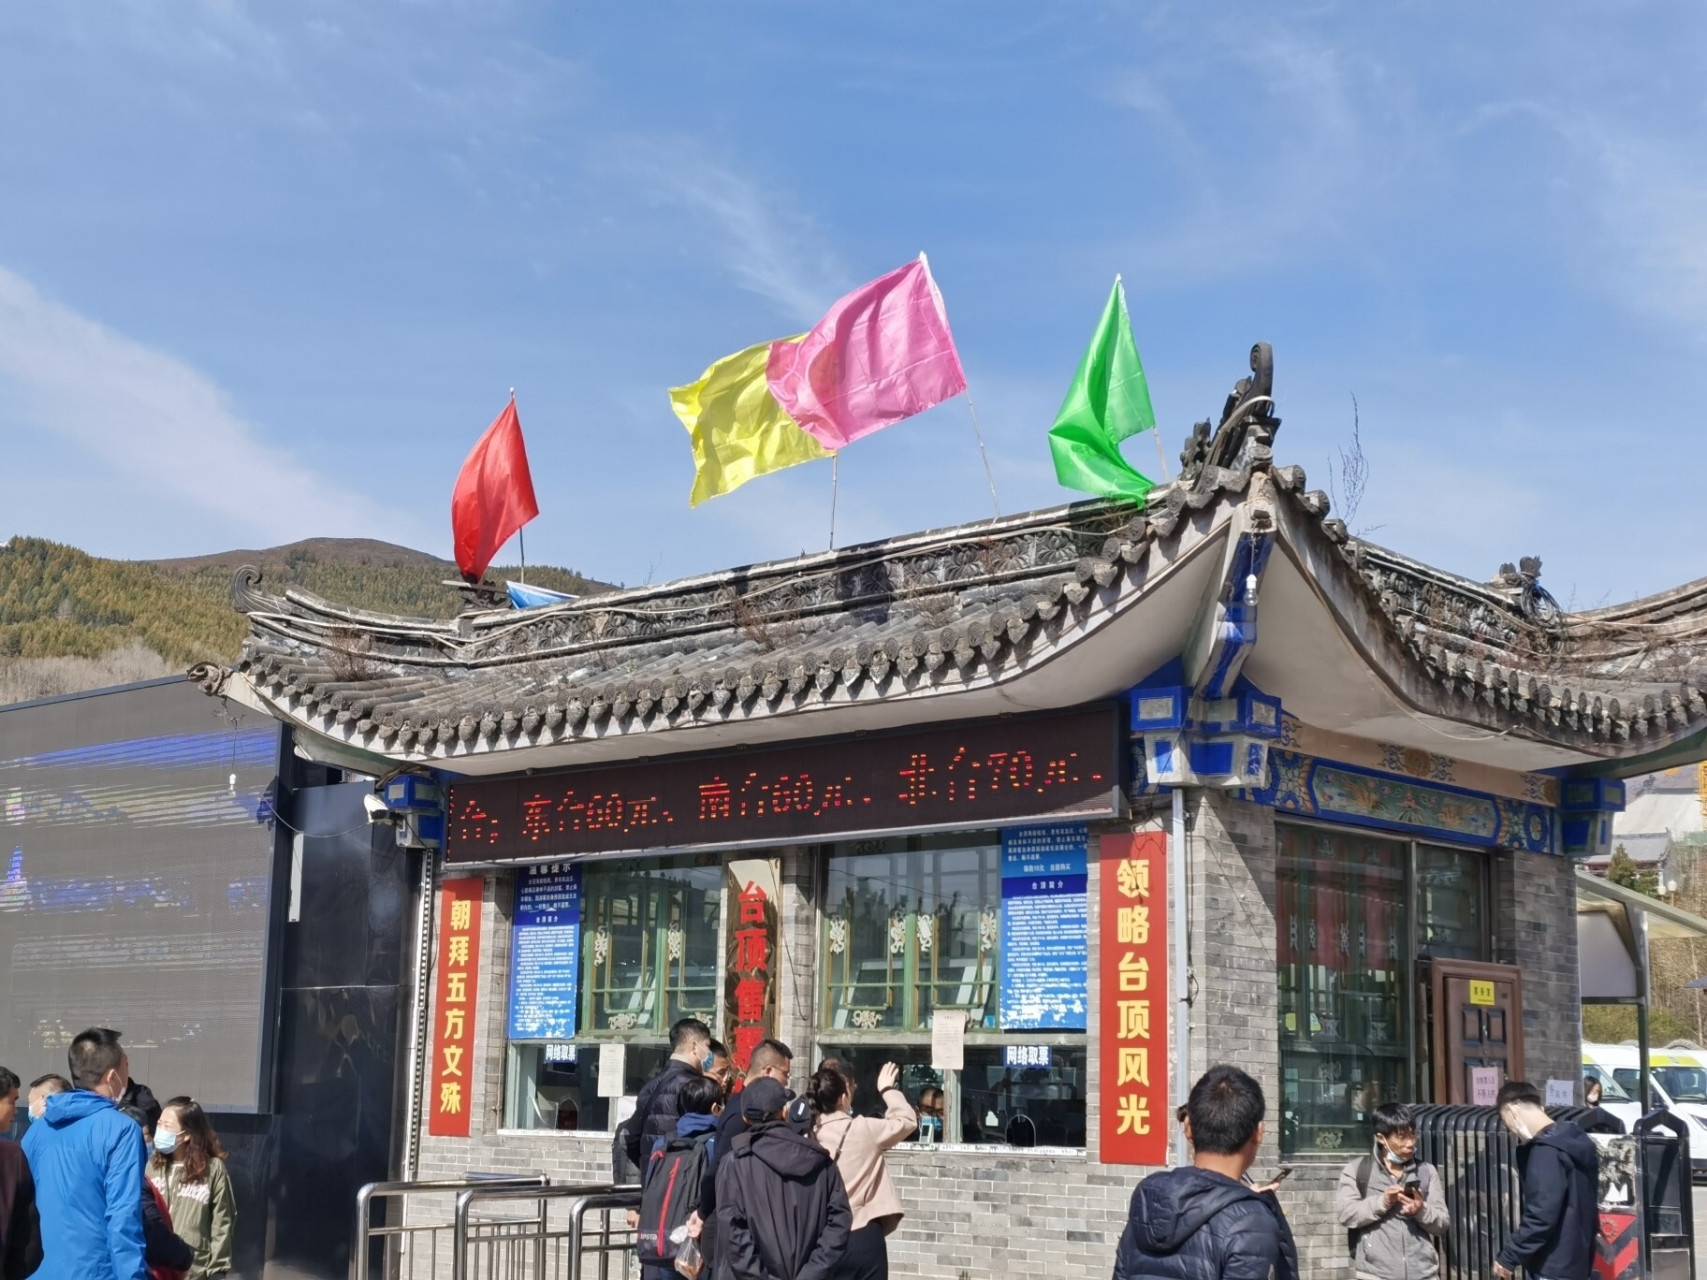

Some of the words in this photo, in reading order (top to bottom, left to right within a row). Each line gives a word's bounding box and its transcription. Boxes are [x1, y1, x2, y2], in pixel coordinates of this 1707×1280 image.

[439, 899, 471, 1115] 朝拜五方文殊
[545, 1044, 577, 1061] 网络取票
[732, 880, 769, 1092] 台顶售票
[1006, 1045, 1049, 1066] 网络取票
[1116, 858, 1150, 1135] 领略台顶风光
